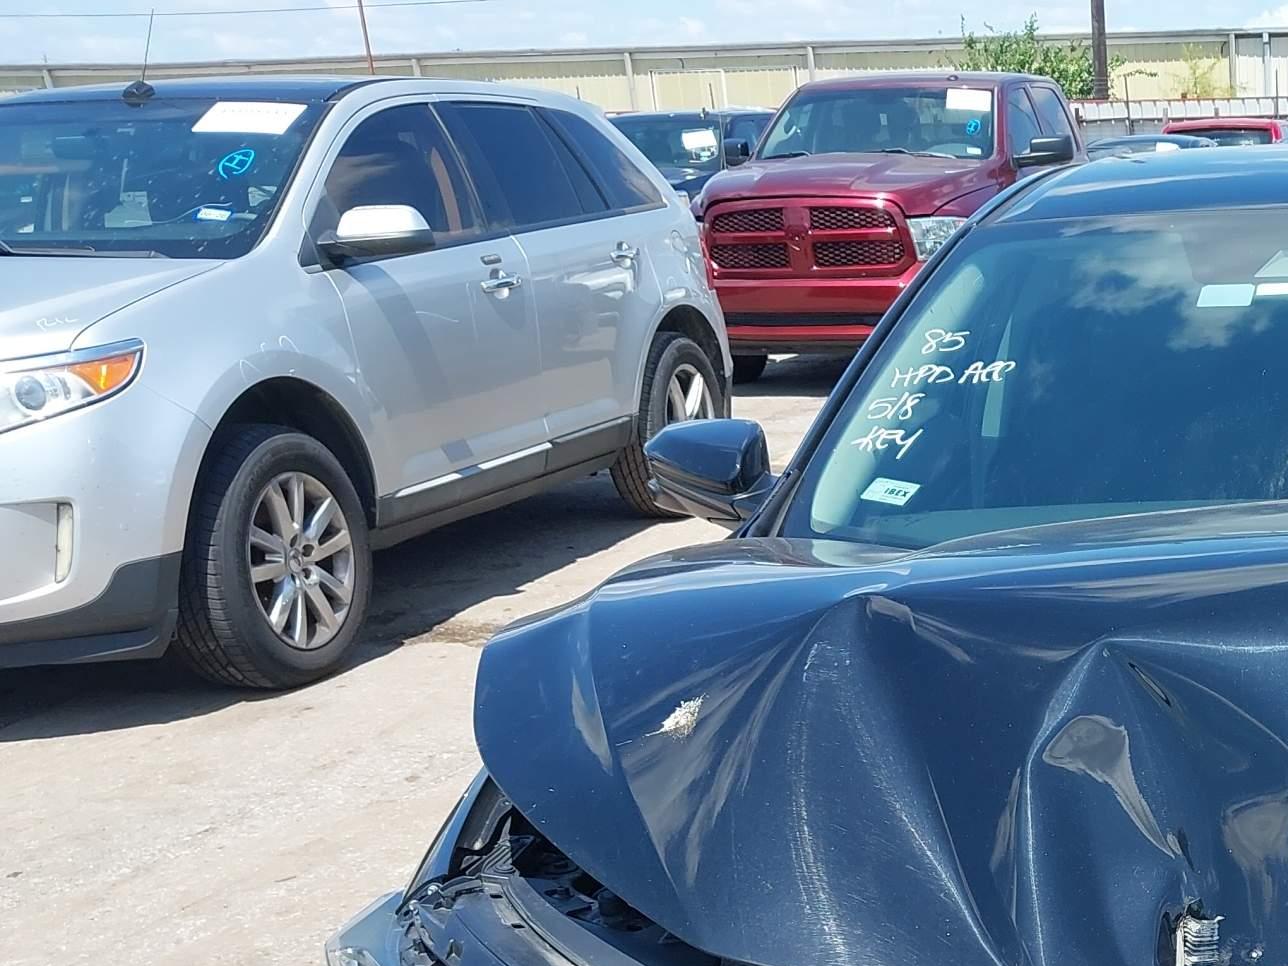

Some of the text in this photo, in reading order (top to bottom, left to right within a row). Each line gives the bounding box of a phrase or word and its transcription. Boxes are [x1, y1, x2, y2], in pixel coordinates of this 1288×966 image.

[921, 328, 971, 354] 85
[867, 392, 928, 421] 5/8
[850, 425, 924, 460] KEY
[883, 487, 911, 498] IBEX
